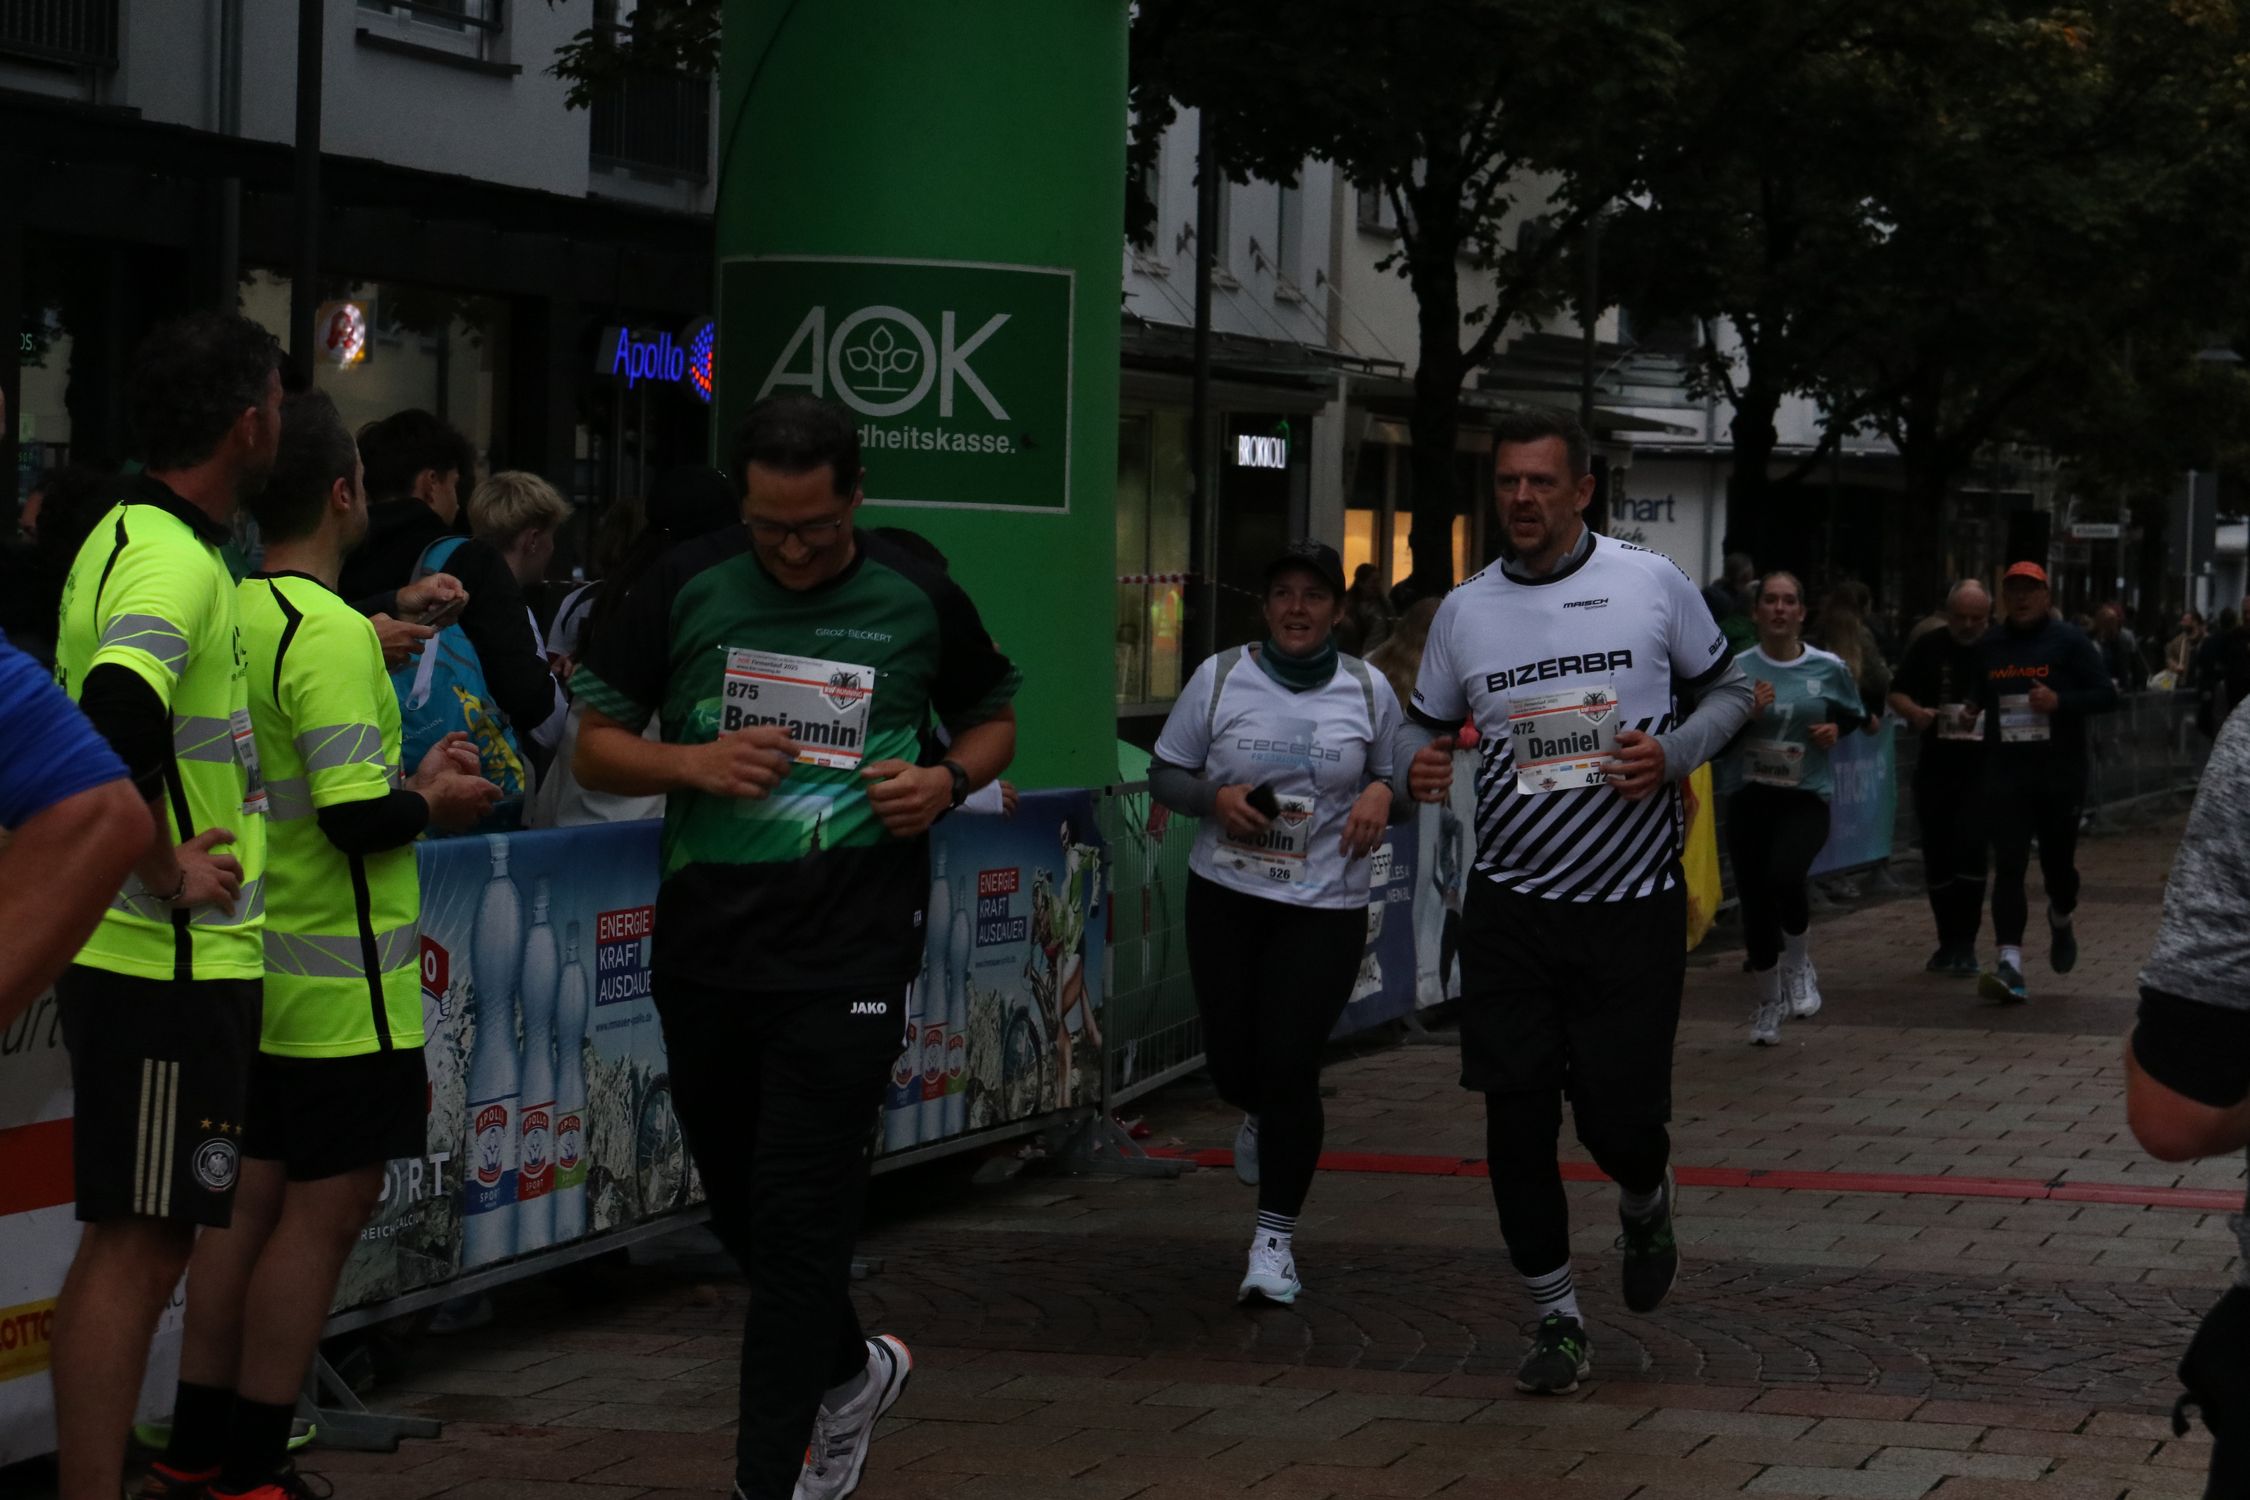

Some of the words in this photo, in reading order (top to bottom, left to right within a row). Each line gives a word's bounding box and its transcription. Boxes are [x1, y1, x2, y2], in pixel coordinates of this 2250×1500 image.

[612, 326, 685, 391] Apollo
[754, 304, 1013, 421] AOK
[856, 424, 1016, 454] dheitskasse.
[1239, 434, 1286, 469] BROKKOLI
[1613, 494, 1675, 522] hart
[1563, 598, 1609, 609] MAISCH
[1486, 649, 1633, 693] BIZERBA
[726, 681, 759, 700] 875
[1512, 721, 1535, 735] 472
[1237, 739, 1342, 762] ceceba
[1528, 729, 1600, 759] Daniel
[1585, 771, 1608, 784] 472
[1753, 760, 1790, 777] Sarah
[980, 870, 1017, 893] ENERGIE
[1269, 867, 1291, 880] 526
[979, 896, 1007, 918] KRAFT
[600, 910, 650, 940] ENERGIE
[599, 942, 639, 971] KRAFT
[598, 969, 653, 1003] AUSDAUE
[850, 1001, 888, 1014] JAKO
[524, 1113, 548, 1129] APOLLO
[0, 1309, 54, 1351] OTTO
